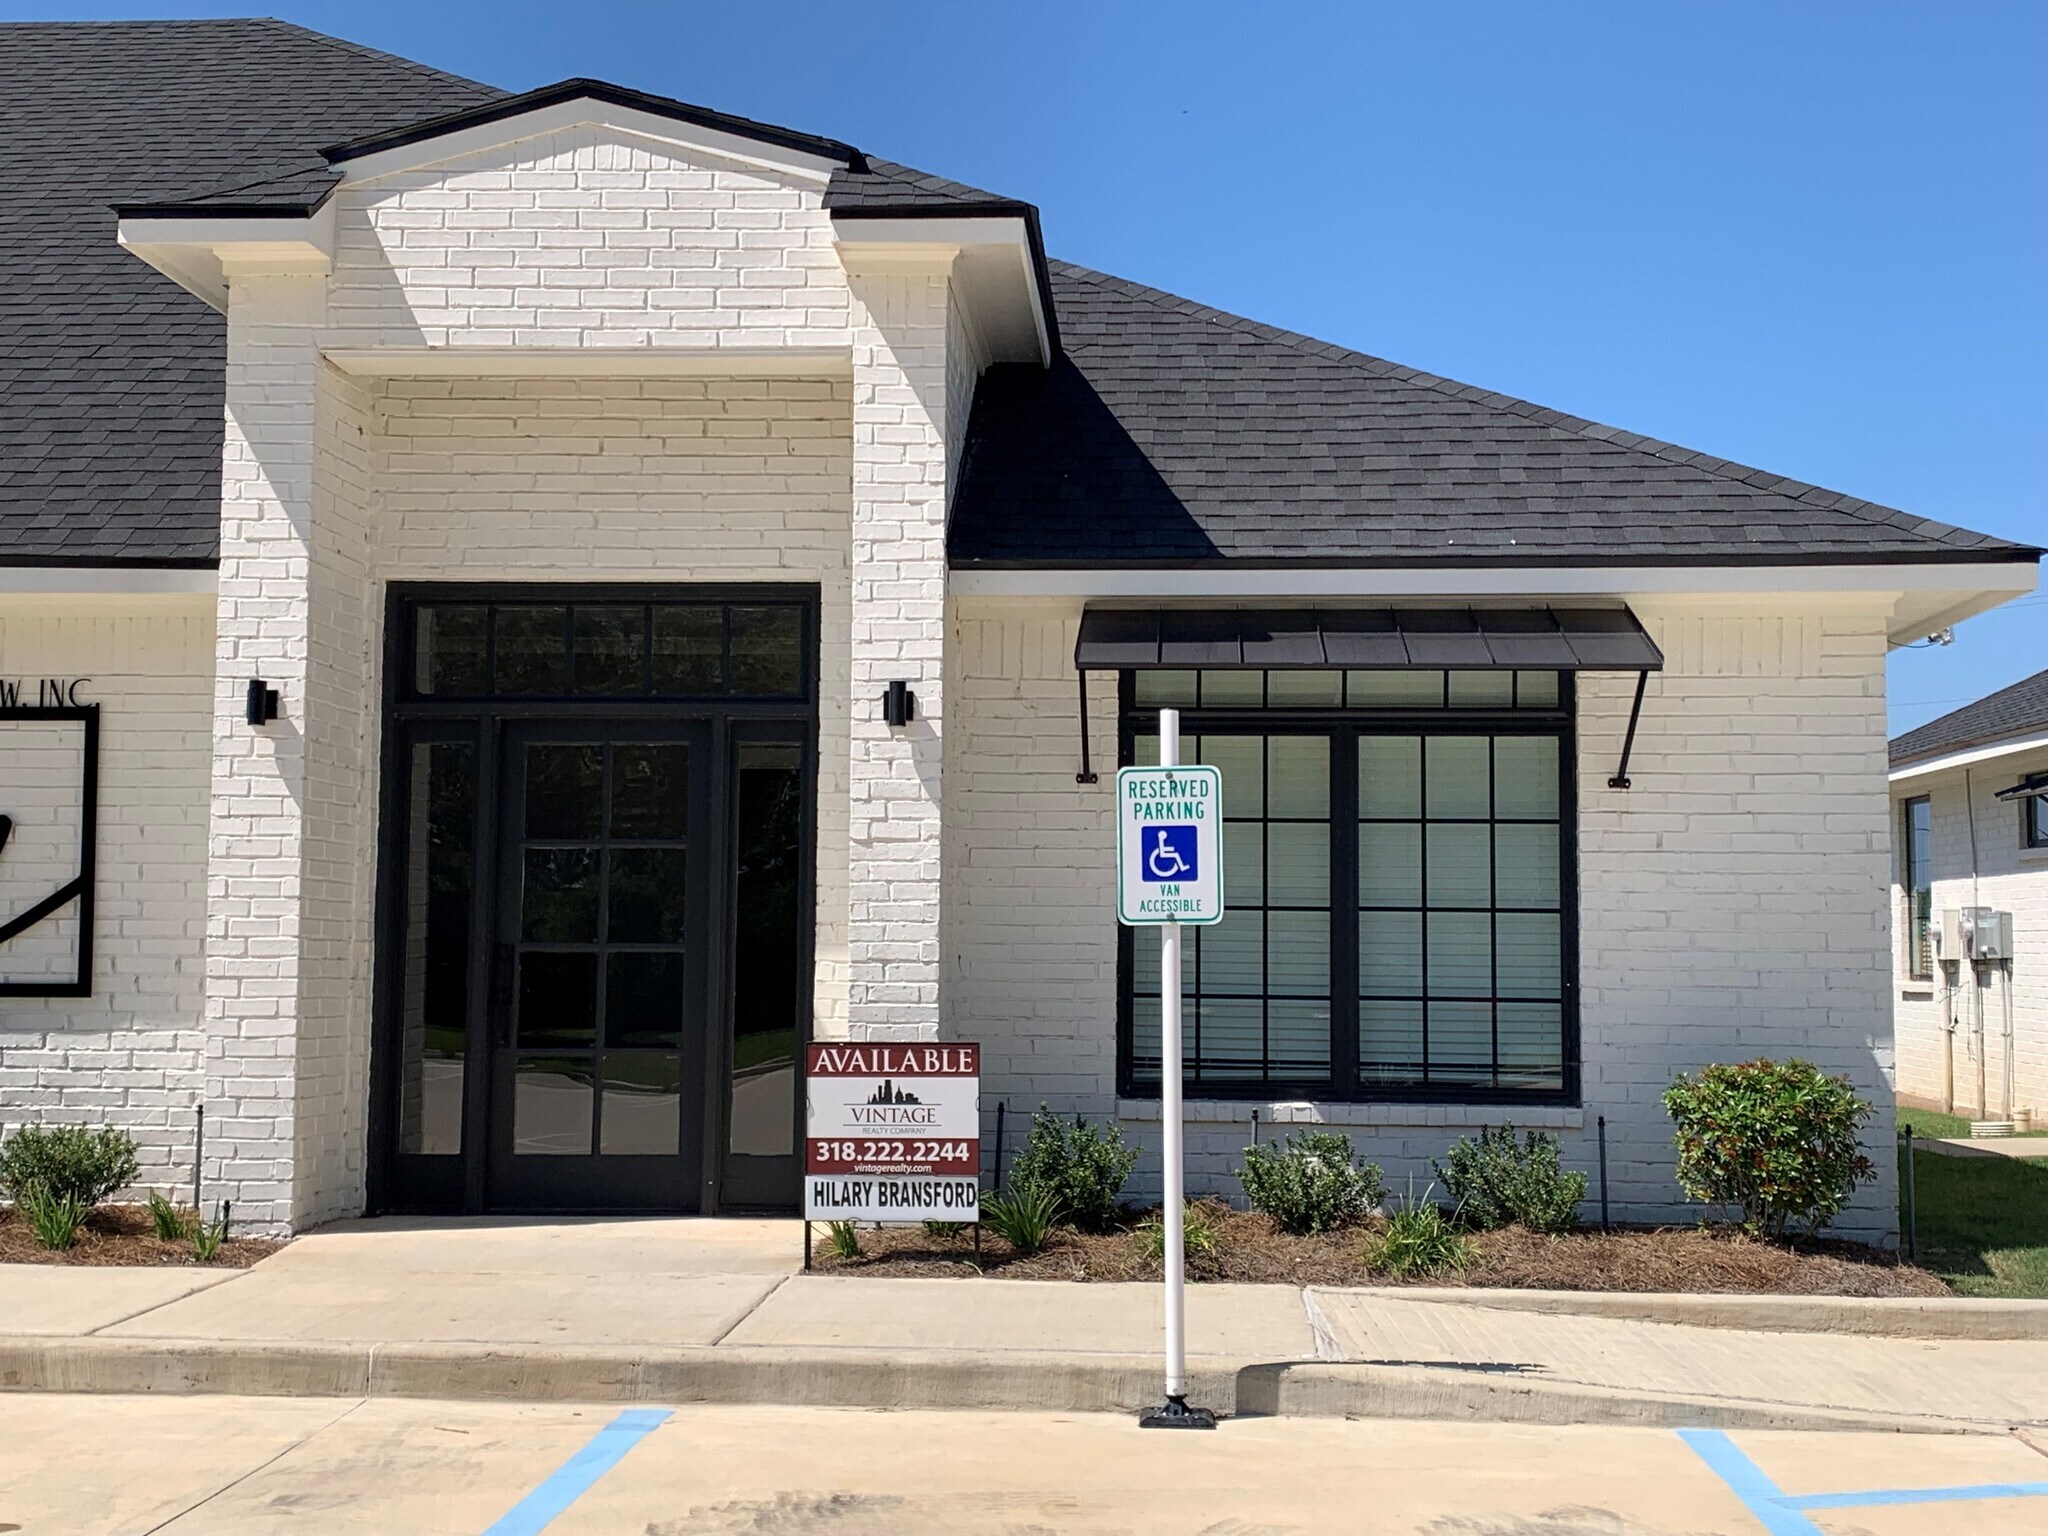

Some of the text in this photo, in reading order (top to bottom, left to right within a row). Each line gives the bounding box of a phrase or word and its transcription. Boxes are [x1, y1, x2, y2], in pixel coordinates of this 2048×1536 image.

[1129, 780, 1209, 799] RESERVED
[1134, 801, 1205, 820] PARKING
[1160, 884, 1180, 896] VAN
[1139, 899, 1202, 912] ACCESSIBLE
[812, 1048, 973, 1073] AVAILABLE
[850, 1107, 936, 1124] VINTAGE
[862, 1127, 927, 1135] REALTY COMPANY
[816, 1142, 970, 1162] 318.222.2244
[854, 1163, 932, 1174] vintagerealty.com
[814, 1181, 976, 1208] HILARY BRANSFORD
